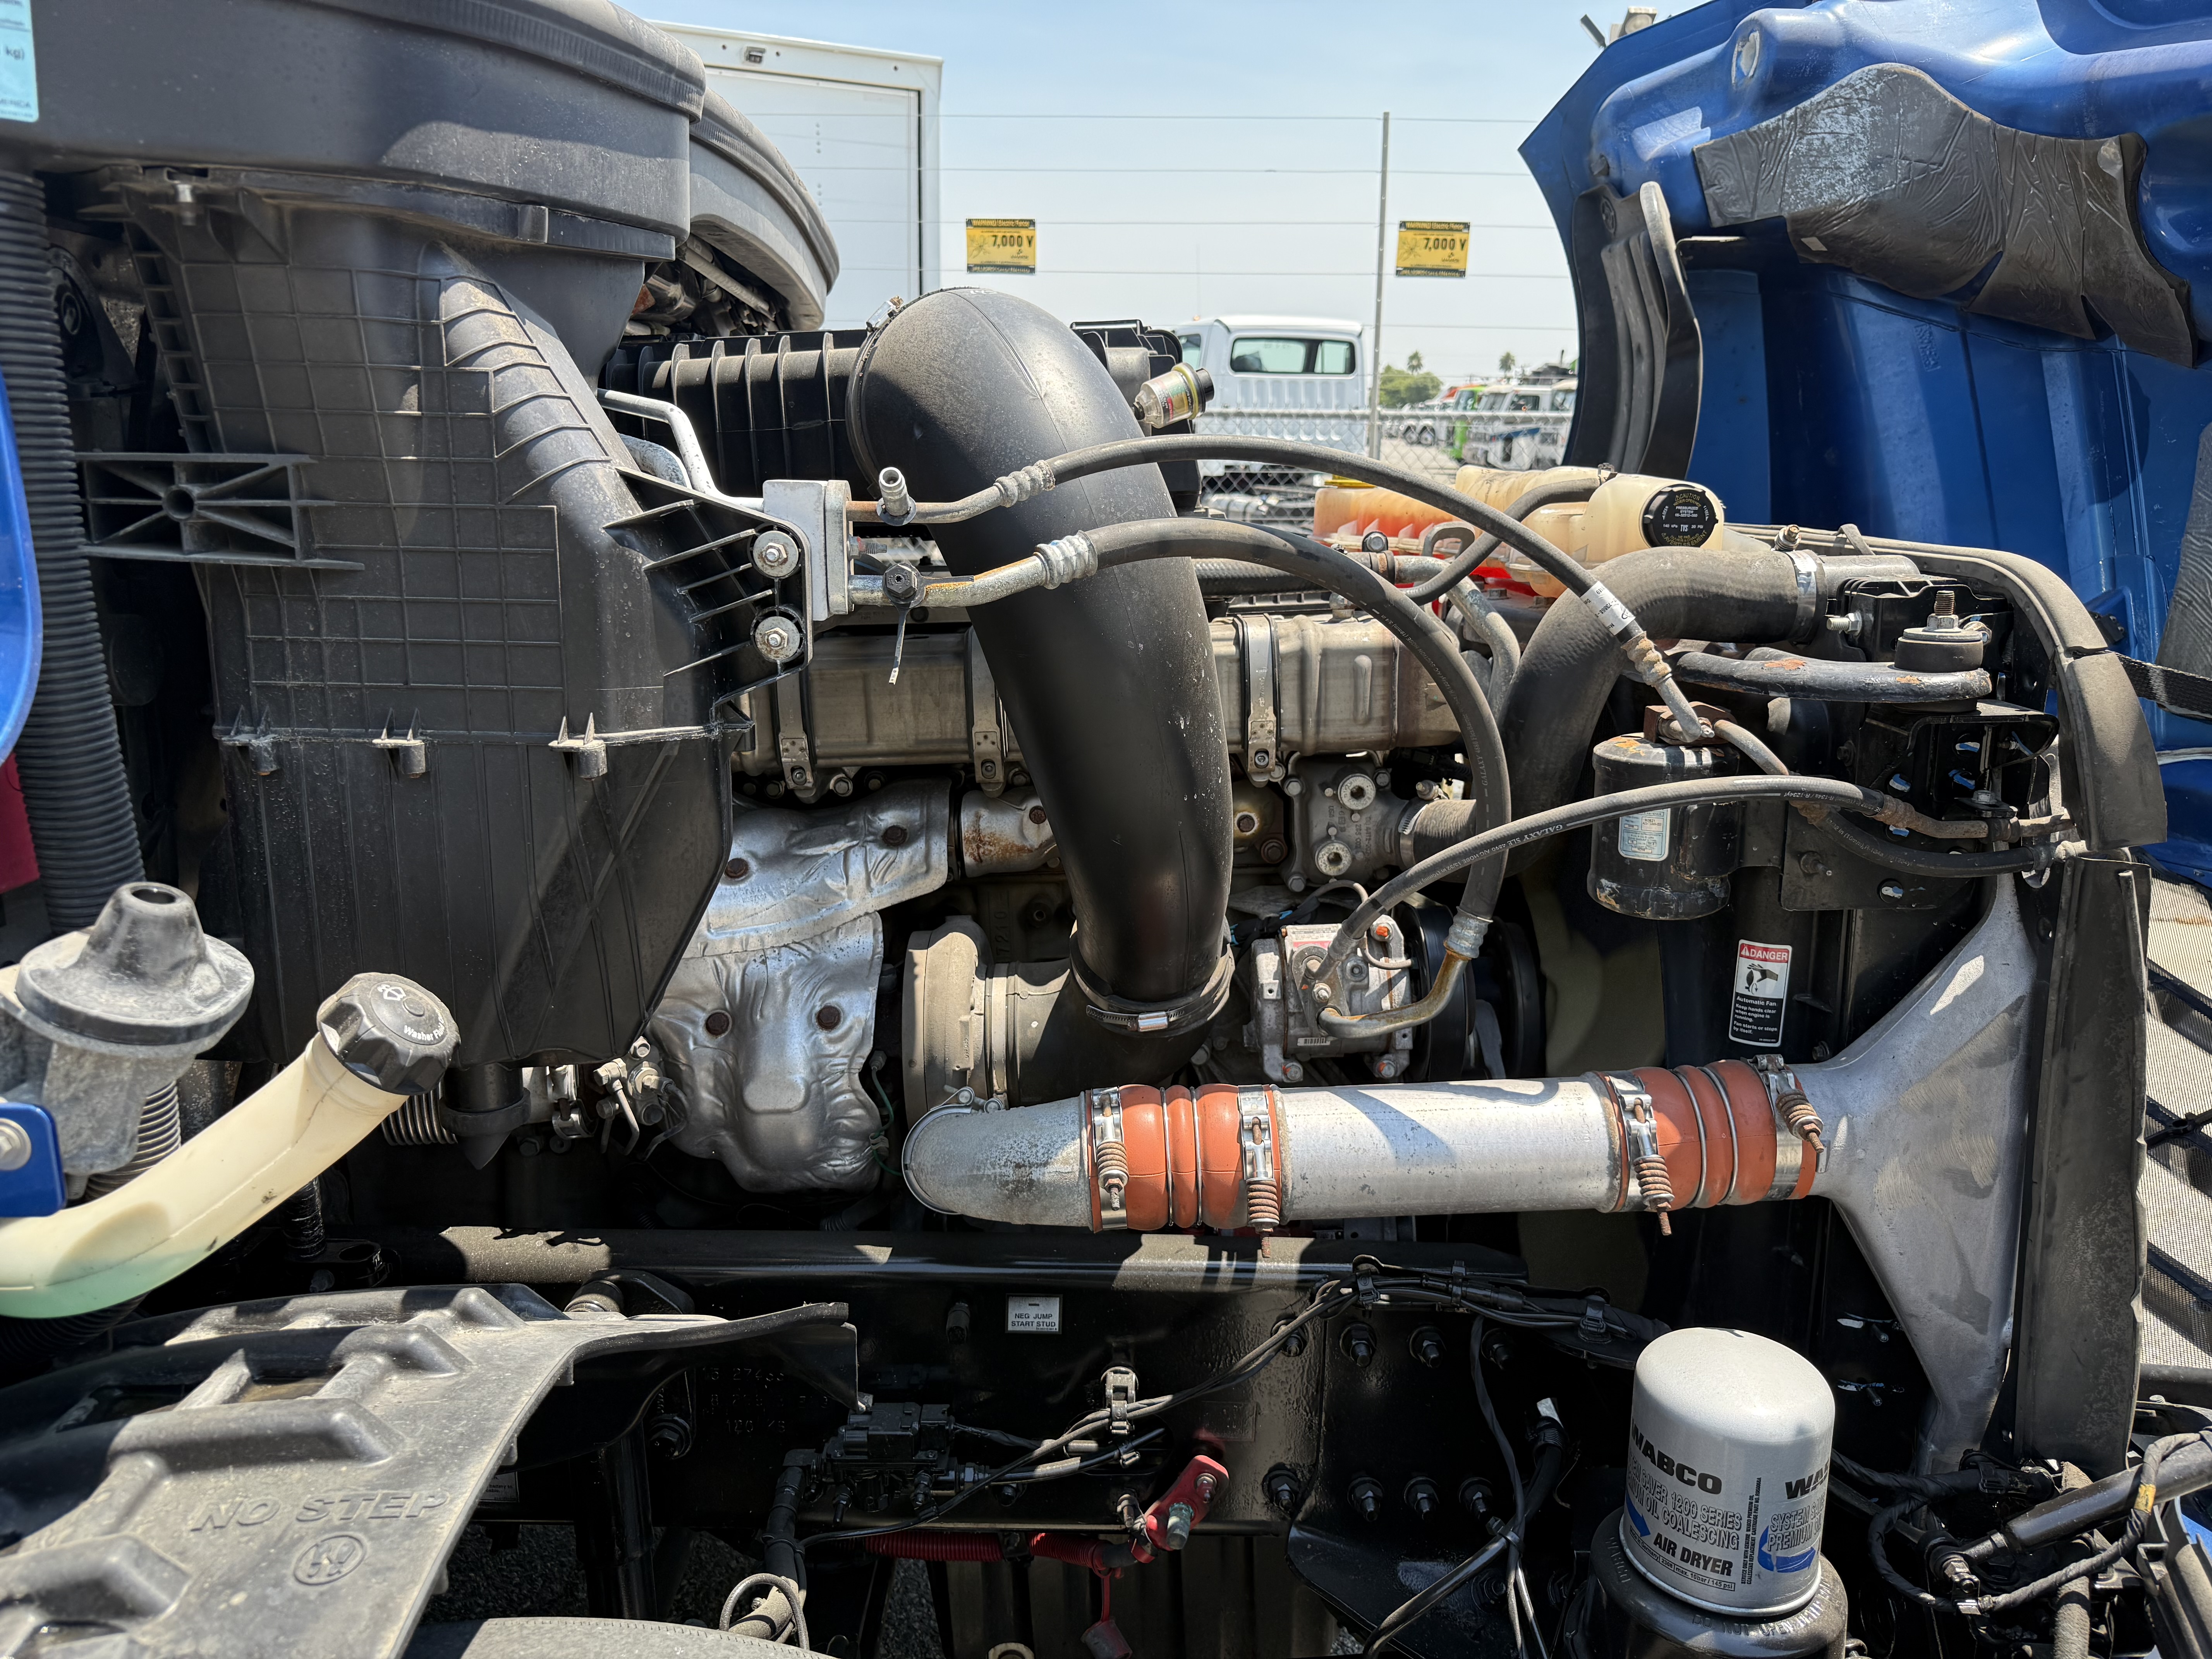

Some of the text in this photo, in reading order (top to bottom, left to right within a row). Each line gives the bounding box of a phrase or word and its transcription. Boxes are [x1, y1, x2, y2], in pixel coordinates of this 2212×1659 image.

[992, 235, 1034, 248] 7,000 V
[1424, 238, 1466, 252] 7,000 V
[1476, 756, 1488, 786] GALAXY
[1507, 837, 1521, 846] SLE
[1523, 824, 1563, 842] GALAXY
[1462, 854, 1479, 864] HOSE
[1750, 949, 1788, 960] DANGER
[1736, 996, 1764, 1006] Automatic
[1735, 1014, 1754, 1022] running.
[404, 1025, 434, 1041] Washer
[433, 1022, 445, 1039] Fluid
[1632, 1416, 1722, 1495] WABCO
[191, 1490, 450, 1532] NO STEP
[1642, 1469, 1668, 1506] SAVER
[1671, 1492, 1698, 1519] 1200
[1700, 1504, 1742, 1531] SERIES
[1646, 1494, 1659, 1520] OIL
[1661, 1506, 1740, 1550] COALESCING
[1770, 1506, 1810, 1532] SYSTEM
[1767, 1522, 1813, 1552] PREMIUM
[1641, 1541, 1659, 1561] Germany
[1675, 1567, 1689, 1577] max.
[1690, 1573, 1707, 1583] 10bar
[1653, 1532, 1733, 1576] AIR DRYER
[1692, 1614, 1794, 1636] DO NOT OPEN
